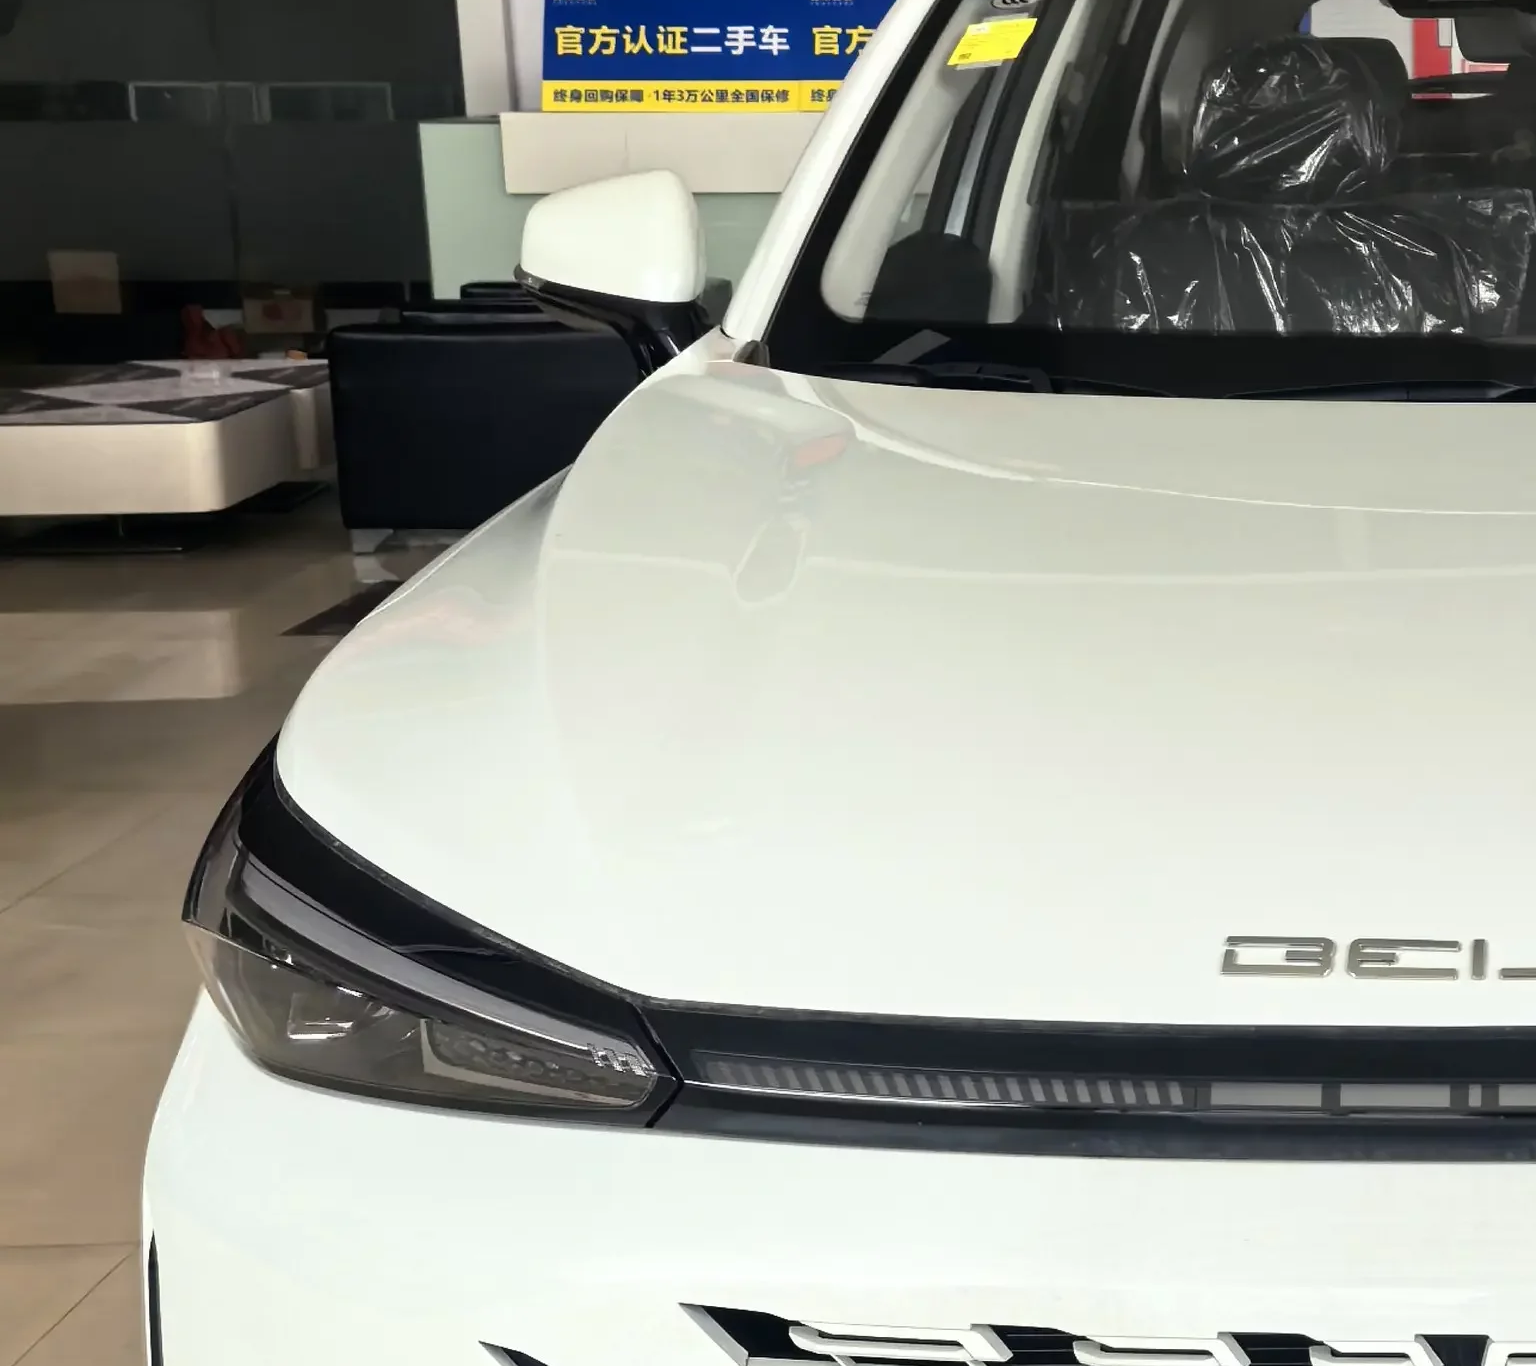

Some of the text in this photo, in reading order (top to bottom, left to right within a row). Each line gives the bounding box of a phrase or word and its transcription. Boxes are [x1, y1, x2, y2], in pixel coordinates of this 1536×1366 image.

[555, 24, 791, 56] 官方认证二手车
[653, 88, 789, 104] 1年3万公里全国保修
